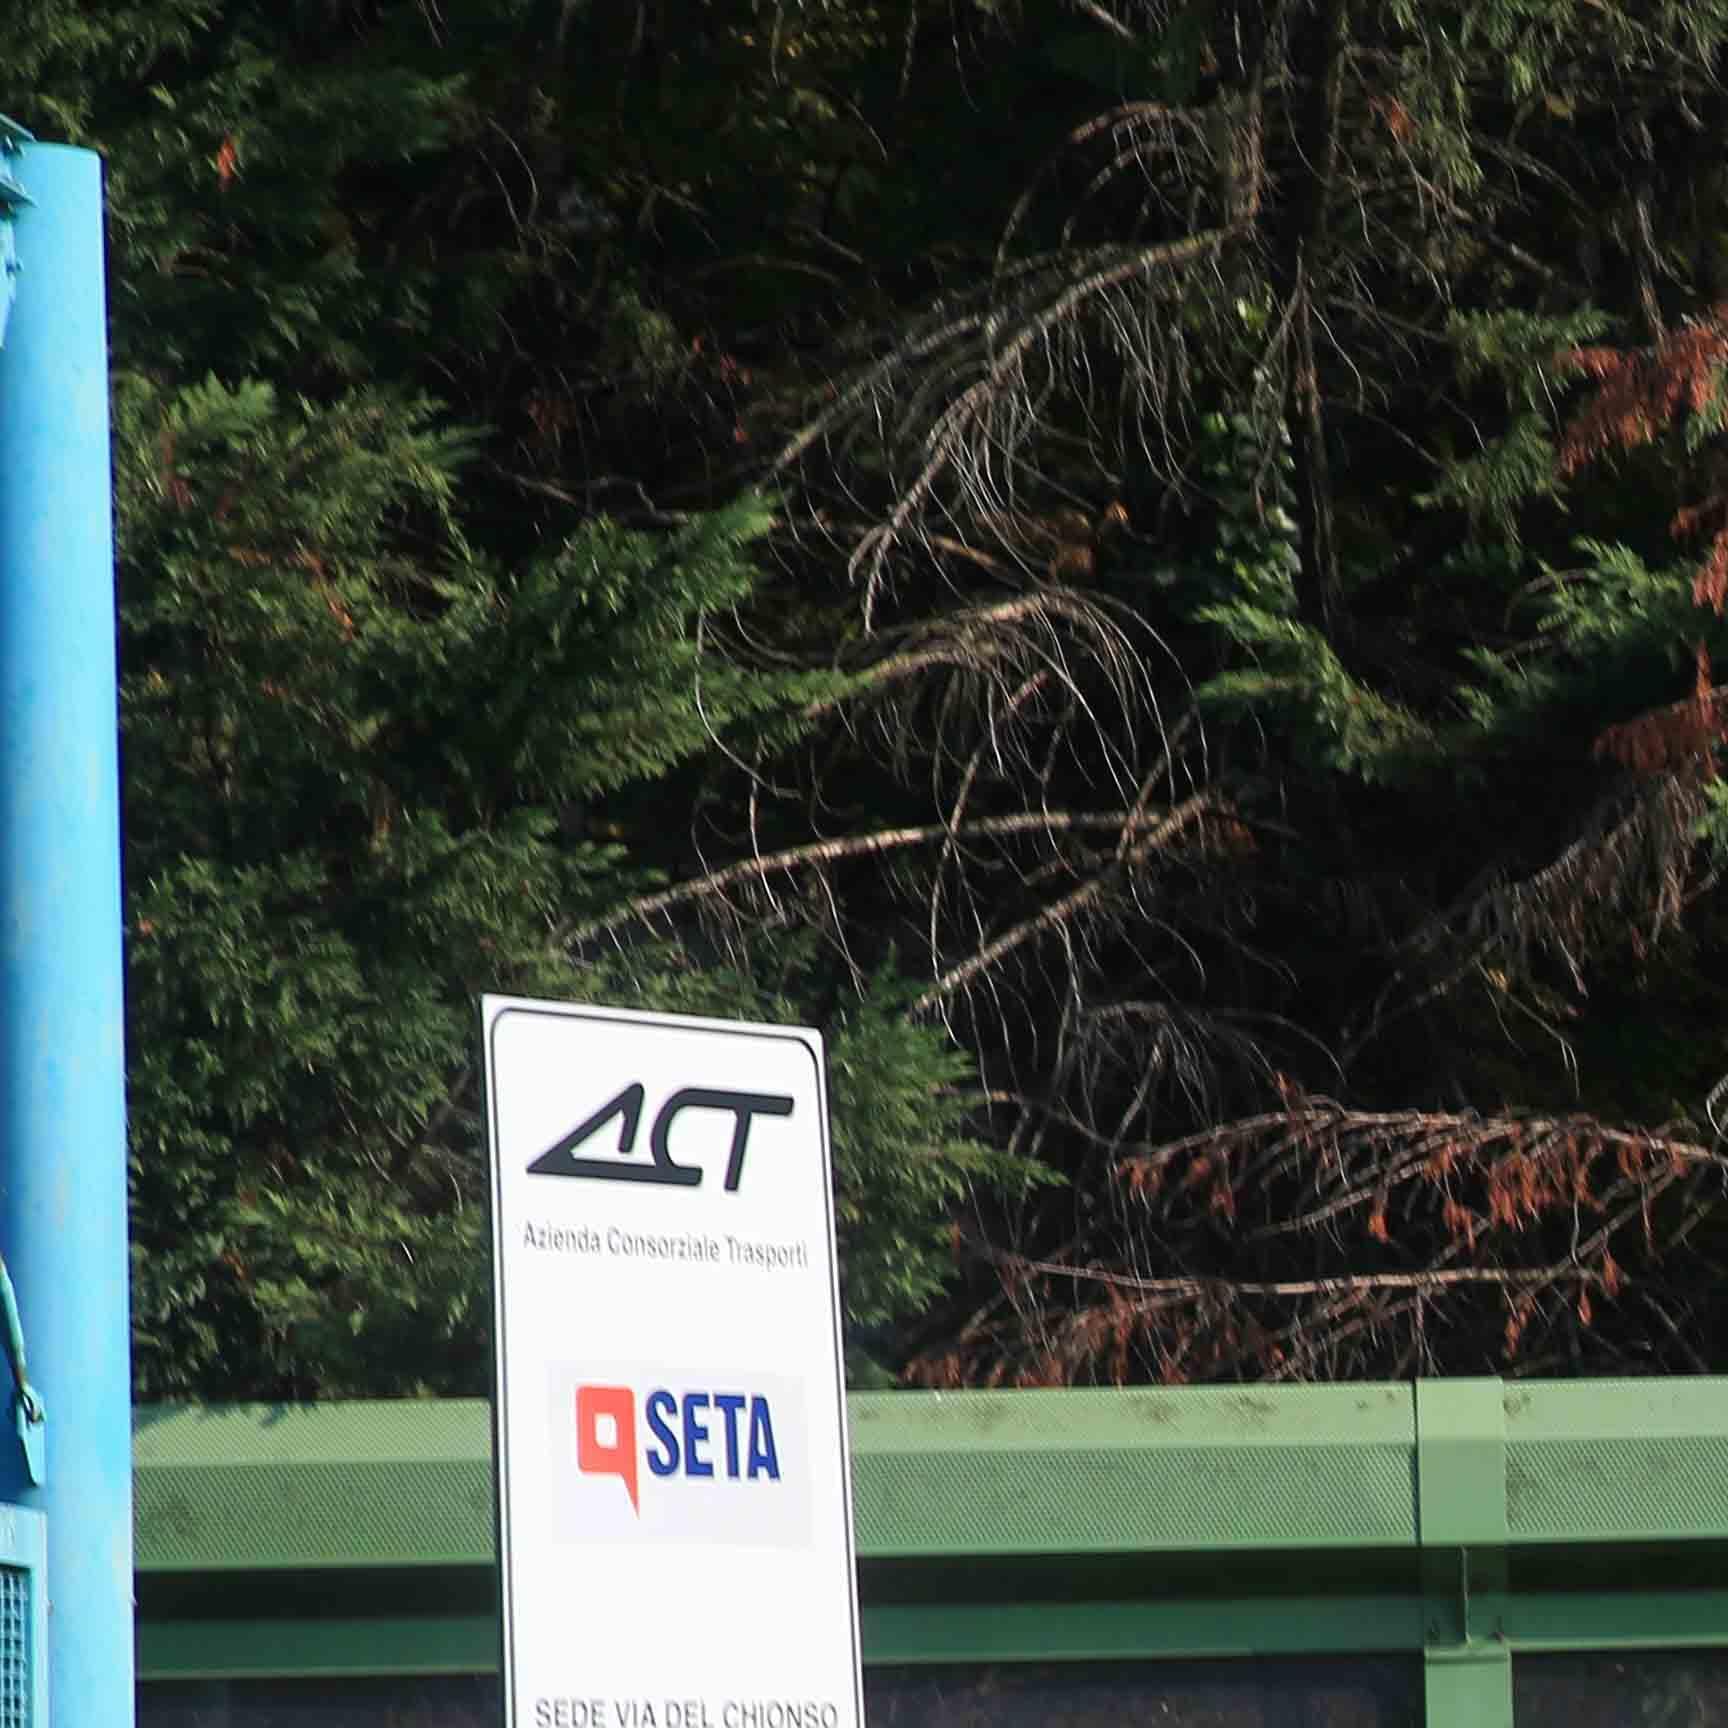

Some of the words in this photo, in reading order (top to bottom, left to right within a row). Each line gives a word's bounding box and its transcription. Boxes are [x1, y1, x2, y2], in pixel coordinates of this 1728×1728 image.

[526, 1083, 794, 1192] ACT
[523, 1221, 600, 1252] Azienda
[608, 1227, 719, 1262] Consorziale
[727, 1236, 808, 1269] Trasporti
[647, 1391, 781, 1480] SETA
[535, 1698, 606, 1728] SEDE
